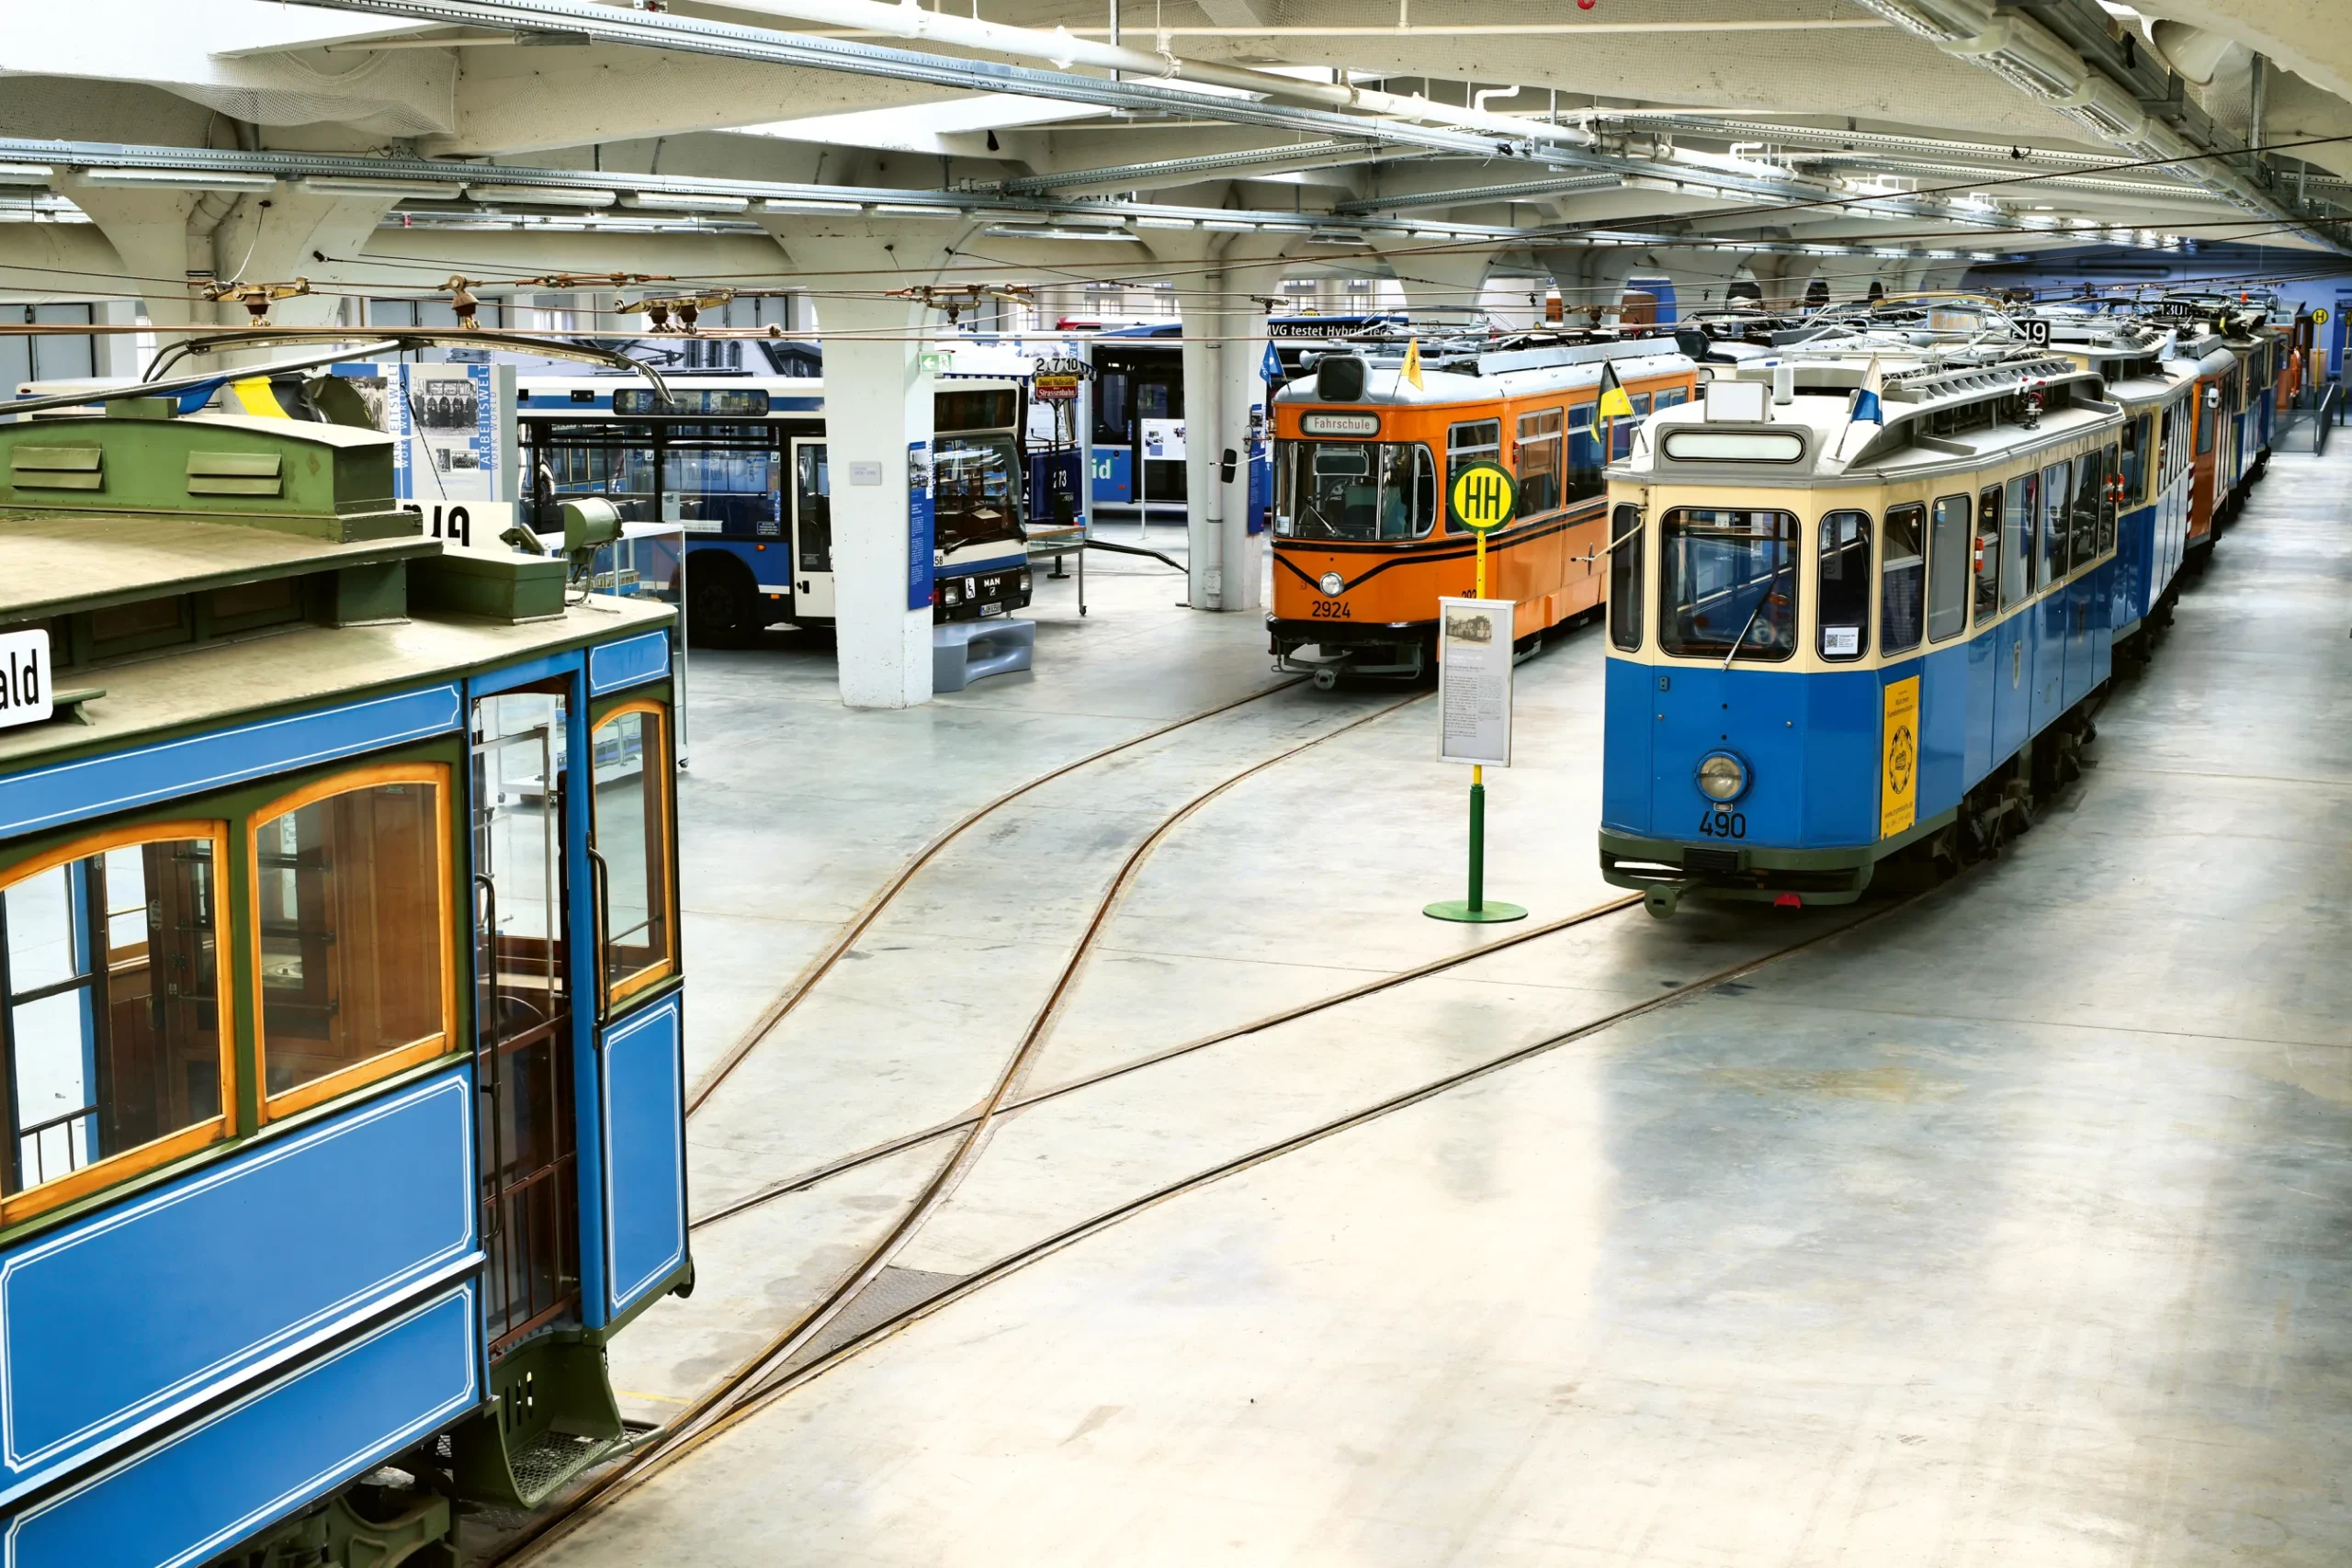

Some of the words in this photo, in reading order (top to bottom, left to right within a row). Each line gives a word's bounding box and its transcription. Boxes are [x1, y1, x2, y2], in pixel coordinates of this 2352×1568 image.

[2315, 311, 2324, 321] H
[1291, 324, 1323, 336] testet
[1035, 357, 1045, 372] 2
[1051, 357, 1060, 372] 7
[1067, 357, 1078, 370] 10
[1038, 388, 1075, 397] Strassenbahn
[478, 365, 491, 465] ARBEITSWELT
[489, 391, 498, 431] WORLD
[1314, 417, 1371, 430] Fahrschule
[490, 437, 499, 470] WORK
[1464, 476, 1500, 519] HH
[933, 555, 944, 566] 58
[983, 577, 1001, 588] MAN
[1311, 599, 1351, 619] 2924
[1699, 811, 1747, 840] 490
